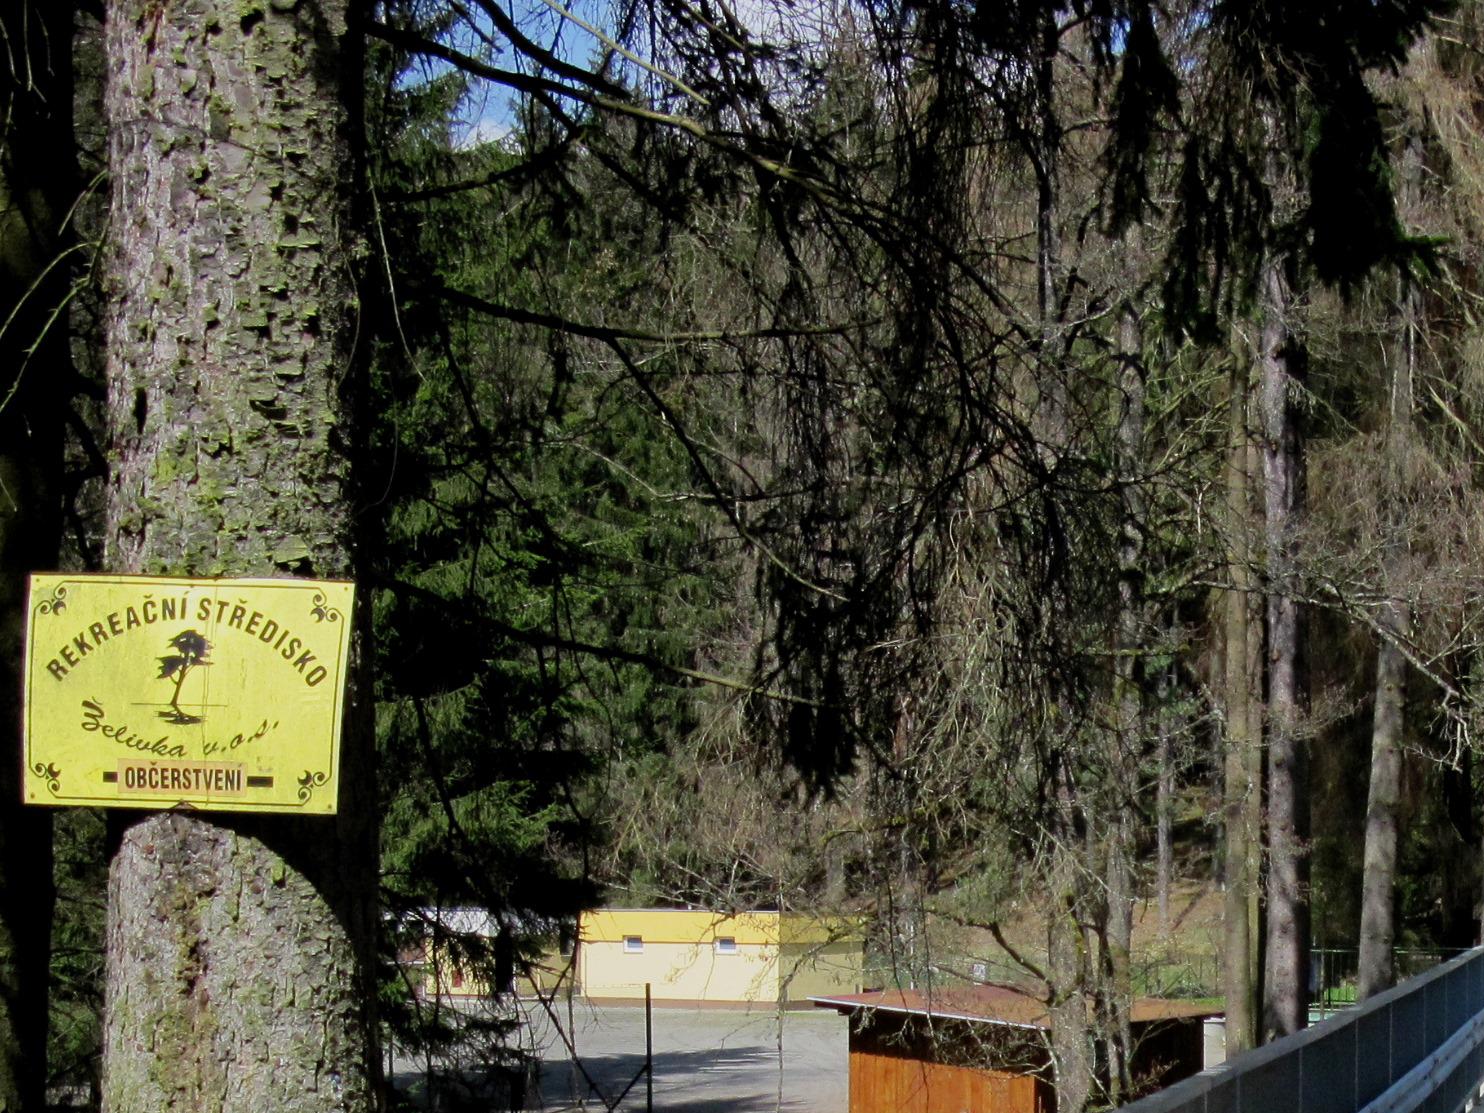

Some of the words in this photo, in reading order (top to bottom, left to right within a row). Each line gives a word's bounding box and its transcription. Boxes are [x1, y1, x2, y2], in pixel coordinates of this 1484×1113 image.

[46, 590, 190, 682] REKREAČNÍ
[197, 597, 329, 688] STŘEDISKO
[81, 695, 188, 758] Želivka
[124, 761, 243, 791] OBČERSTVENÍ
